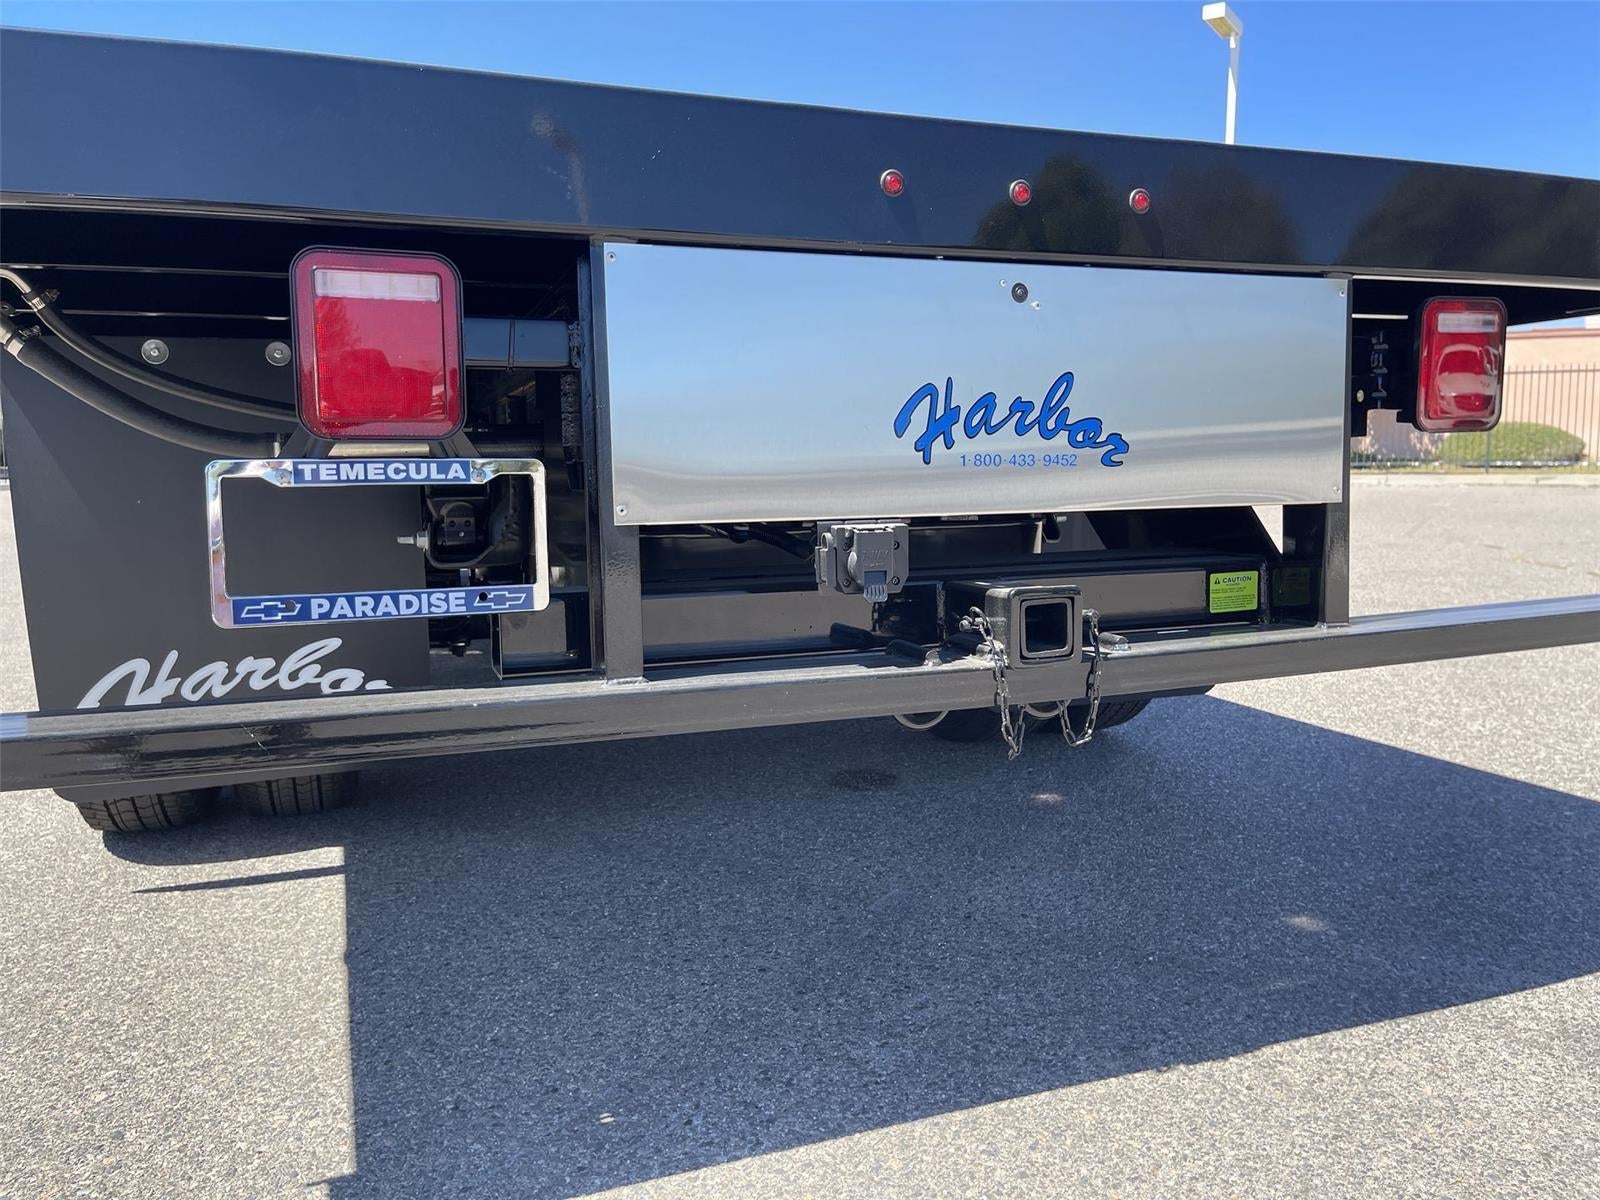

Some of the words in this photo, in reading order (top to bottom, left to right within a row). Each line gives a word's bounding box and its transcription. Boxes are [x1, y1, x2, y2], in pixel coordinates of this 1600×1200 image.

[893, 371, 1130, 467] Harbor
[298, 463, 466, 481] TEMECULA
[310, 592, 466, 619] PARADISE
[77, 637, 393, 709] Harbo
